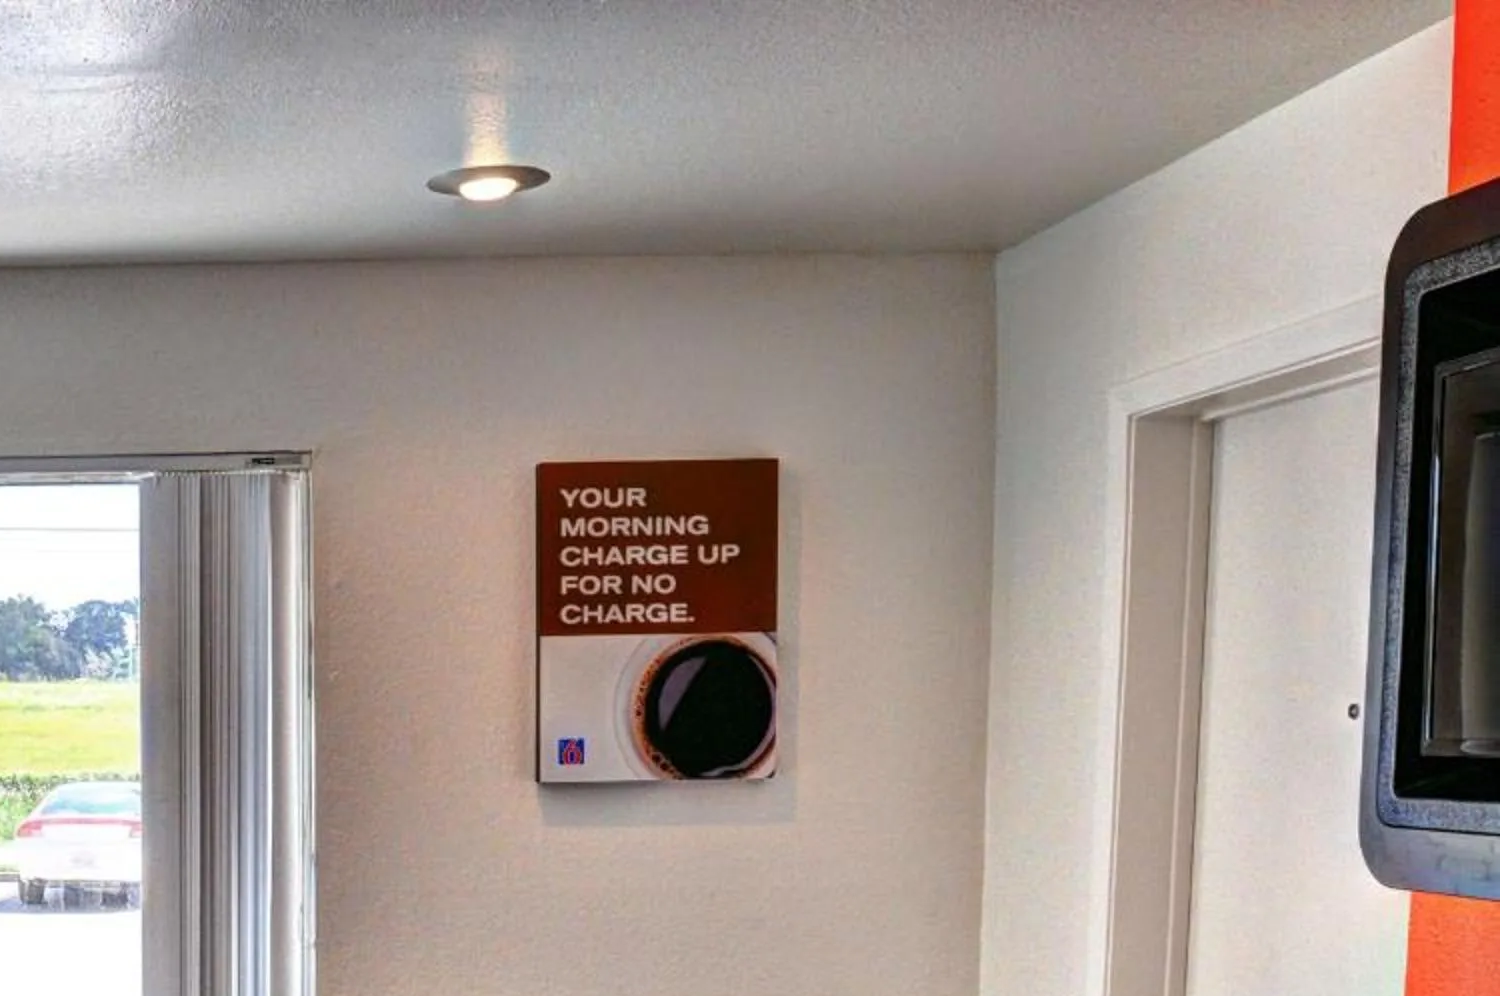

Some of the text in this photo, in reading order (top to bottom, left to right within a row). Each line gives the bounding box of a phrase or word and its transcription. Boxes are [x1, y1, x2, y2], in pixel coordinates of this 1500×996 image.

[560, 488, 647, 509] YOUR
[560, 515, 710, 538] MORNING
[560, 544, 741, 568] CHARGE UP
[560, 573, 676, 596] FOR NO
[560, 602, 696, 625] CHARGE.
